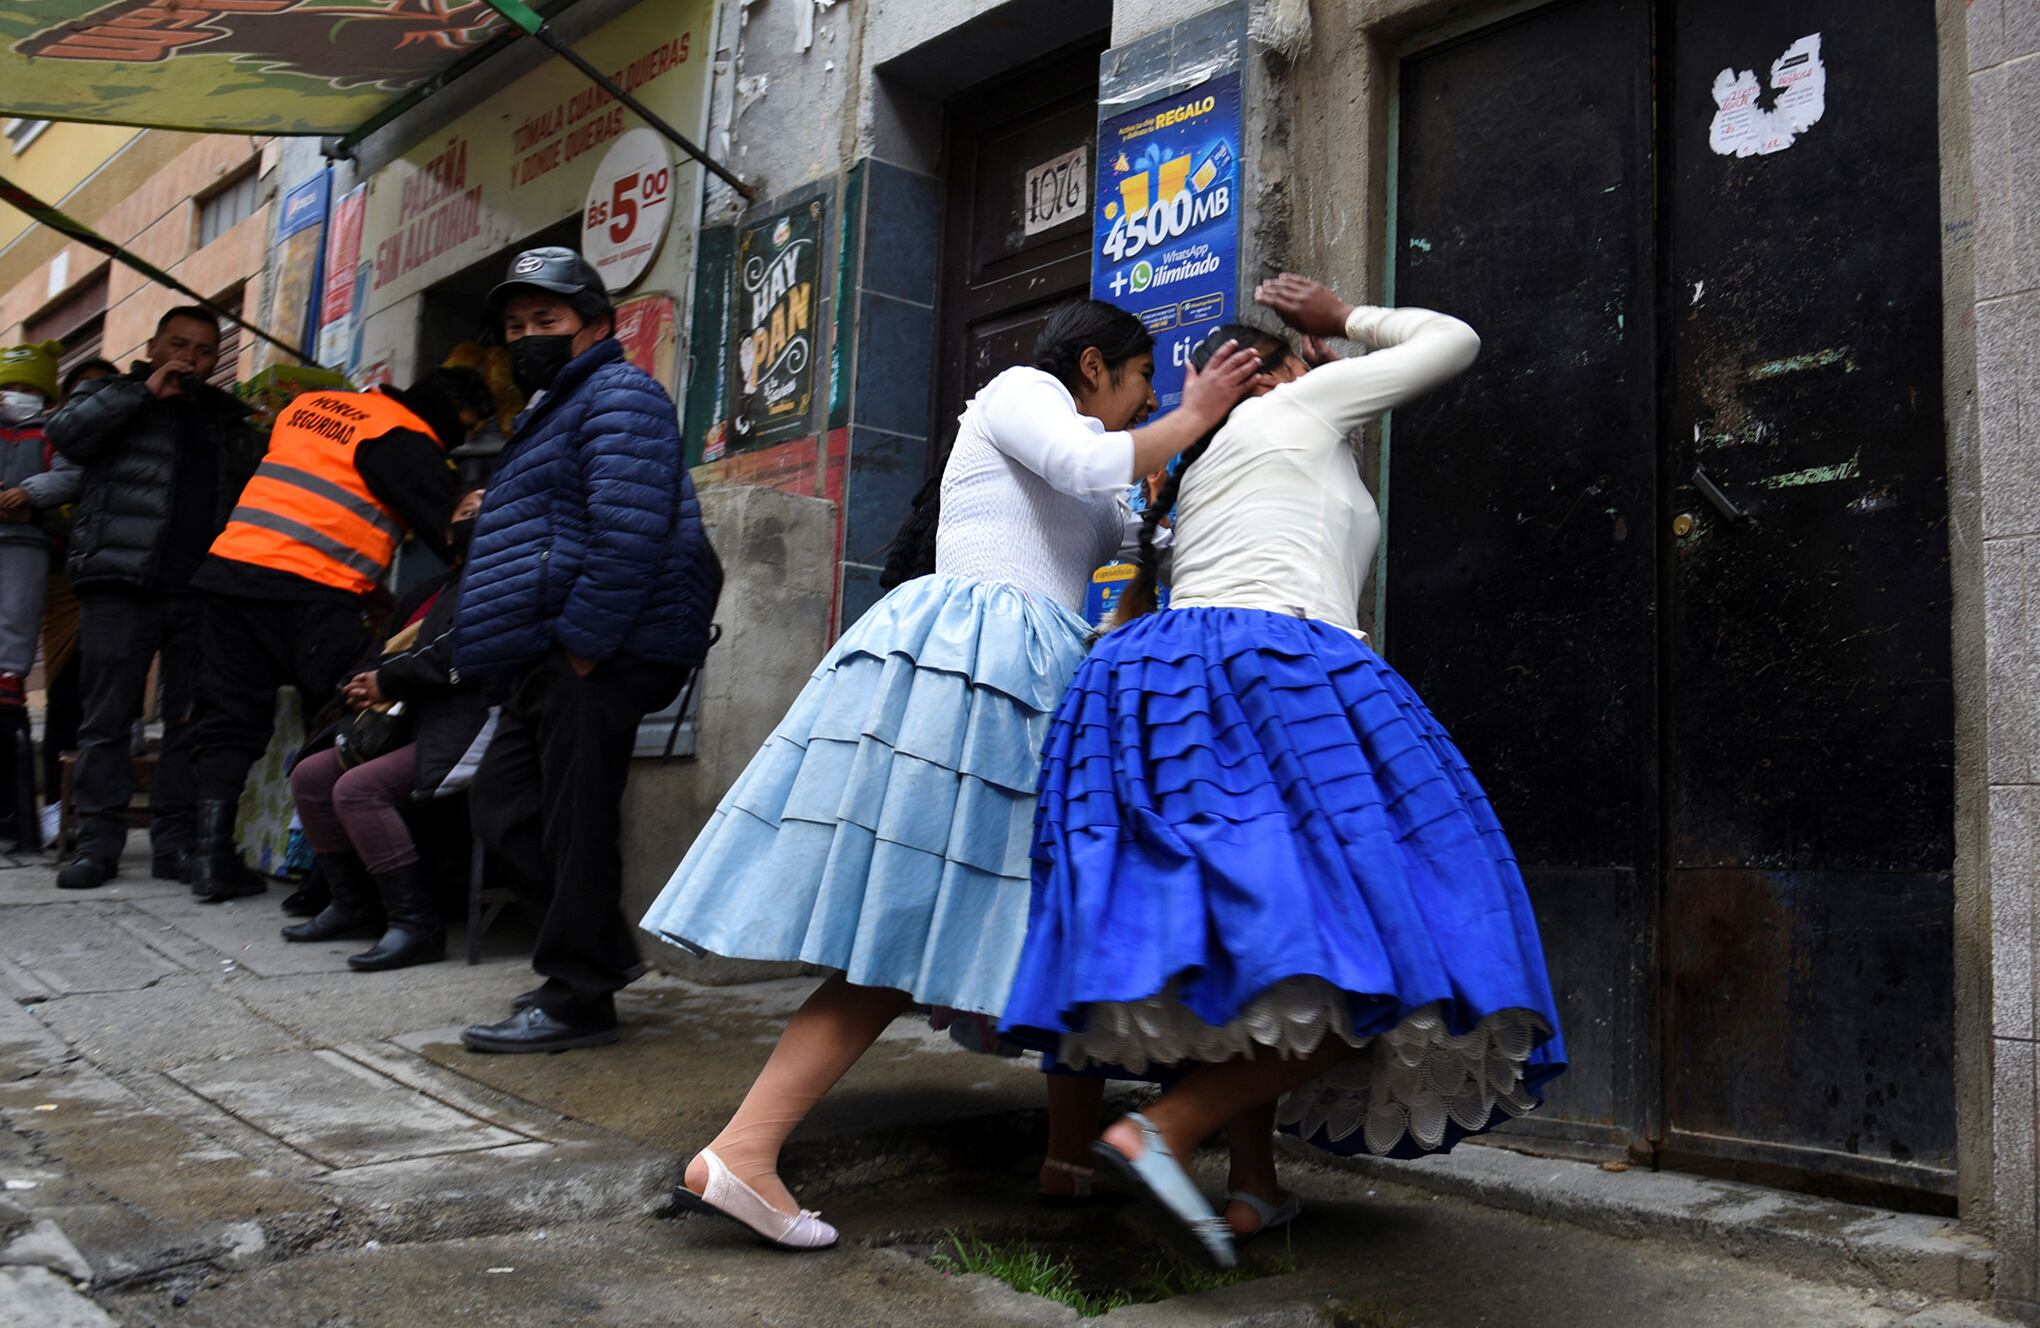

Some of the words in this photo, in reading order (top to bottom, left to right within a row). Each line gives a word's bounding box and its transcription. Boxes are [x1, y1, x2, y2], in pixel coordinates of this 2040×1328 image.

[626, 31, 691, 93] QUIERAS
[1155, 96, 1215, 130] REGALO
[1030, 156, 1080, 223] 1076
[373, 230, 404, 290] SIN
[402, 184, 483, 276] ALCOHOL
[1163, 244, 1208, 265] WhatsApp
[752, 245, 800, 329] HAY
[1152, 252, 1220, 288] ilimitado
[752, 282, 811, 387] PAN
[287, 408, 356, 445] SEGURIDAD
[309, 396, 371, 421] HORUS
